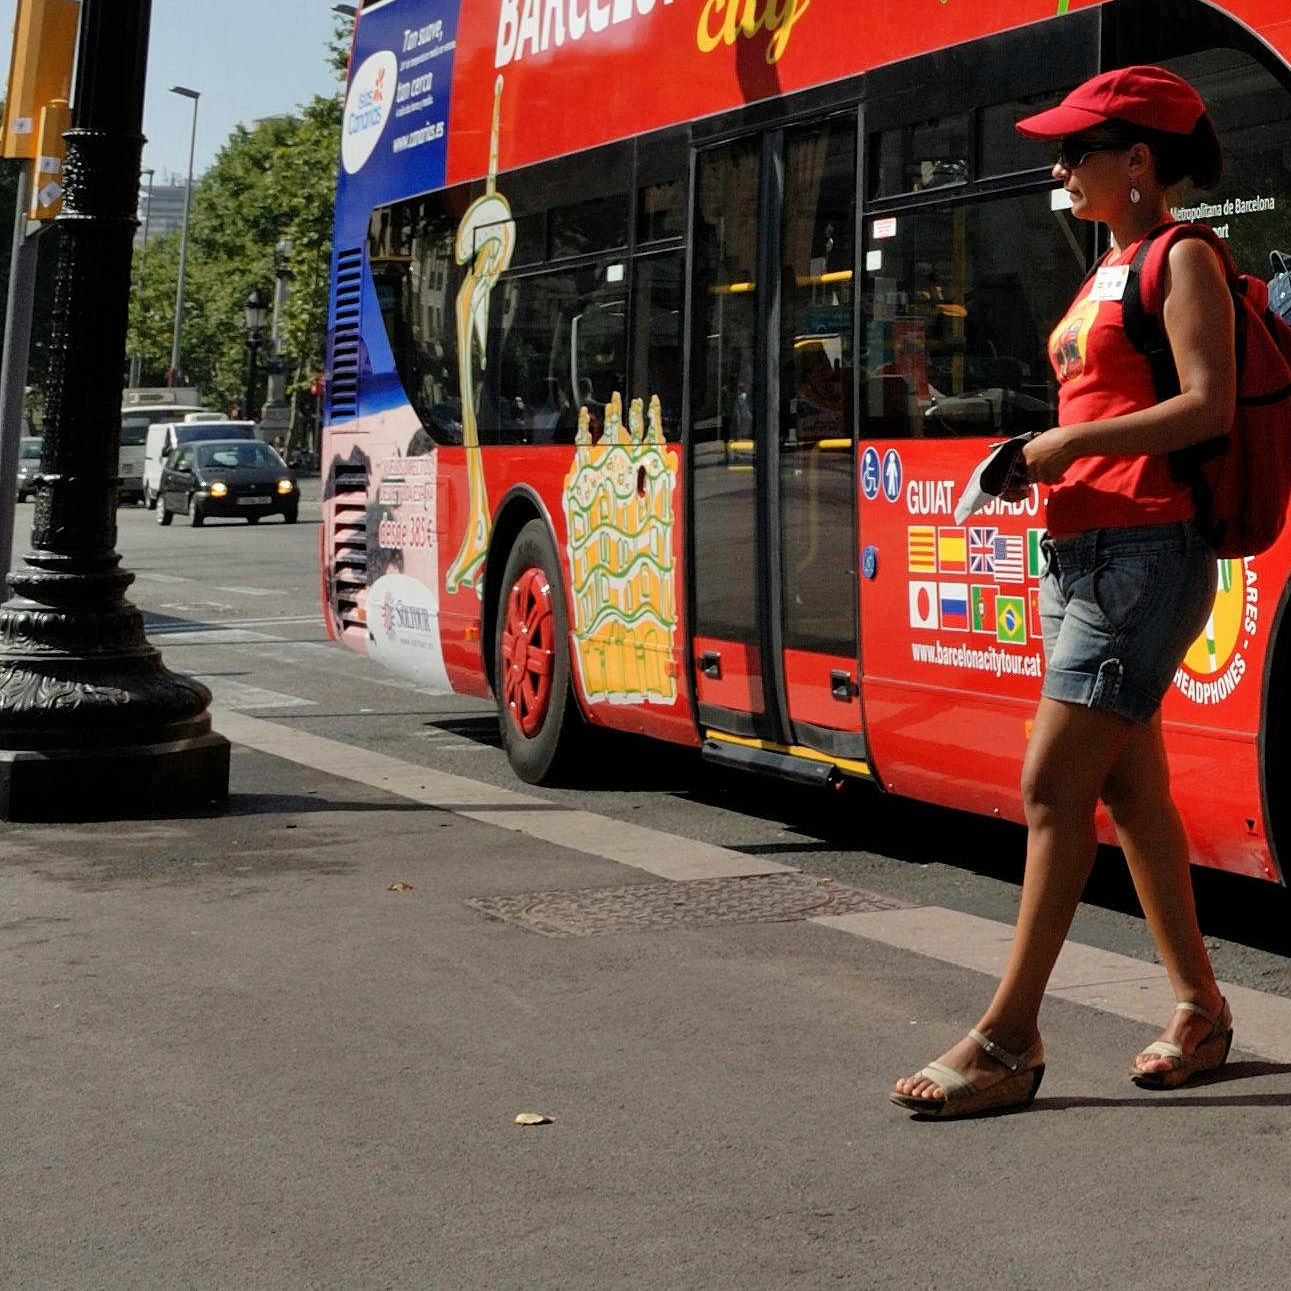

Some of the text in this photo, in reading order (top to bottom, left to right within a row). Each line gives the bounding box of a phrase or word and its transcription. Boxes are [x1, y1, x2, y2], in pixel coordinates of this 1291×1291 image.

[1223, 198, 1234, 216] de
[1235, 195, 1275, 214] Barcelona
[906, 480, 955, 515] GUIAT
[911, 640, 1042, 678] www.barcelonacitytour.cat
[1172, 652, 1246, 705] HEADPHONES
